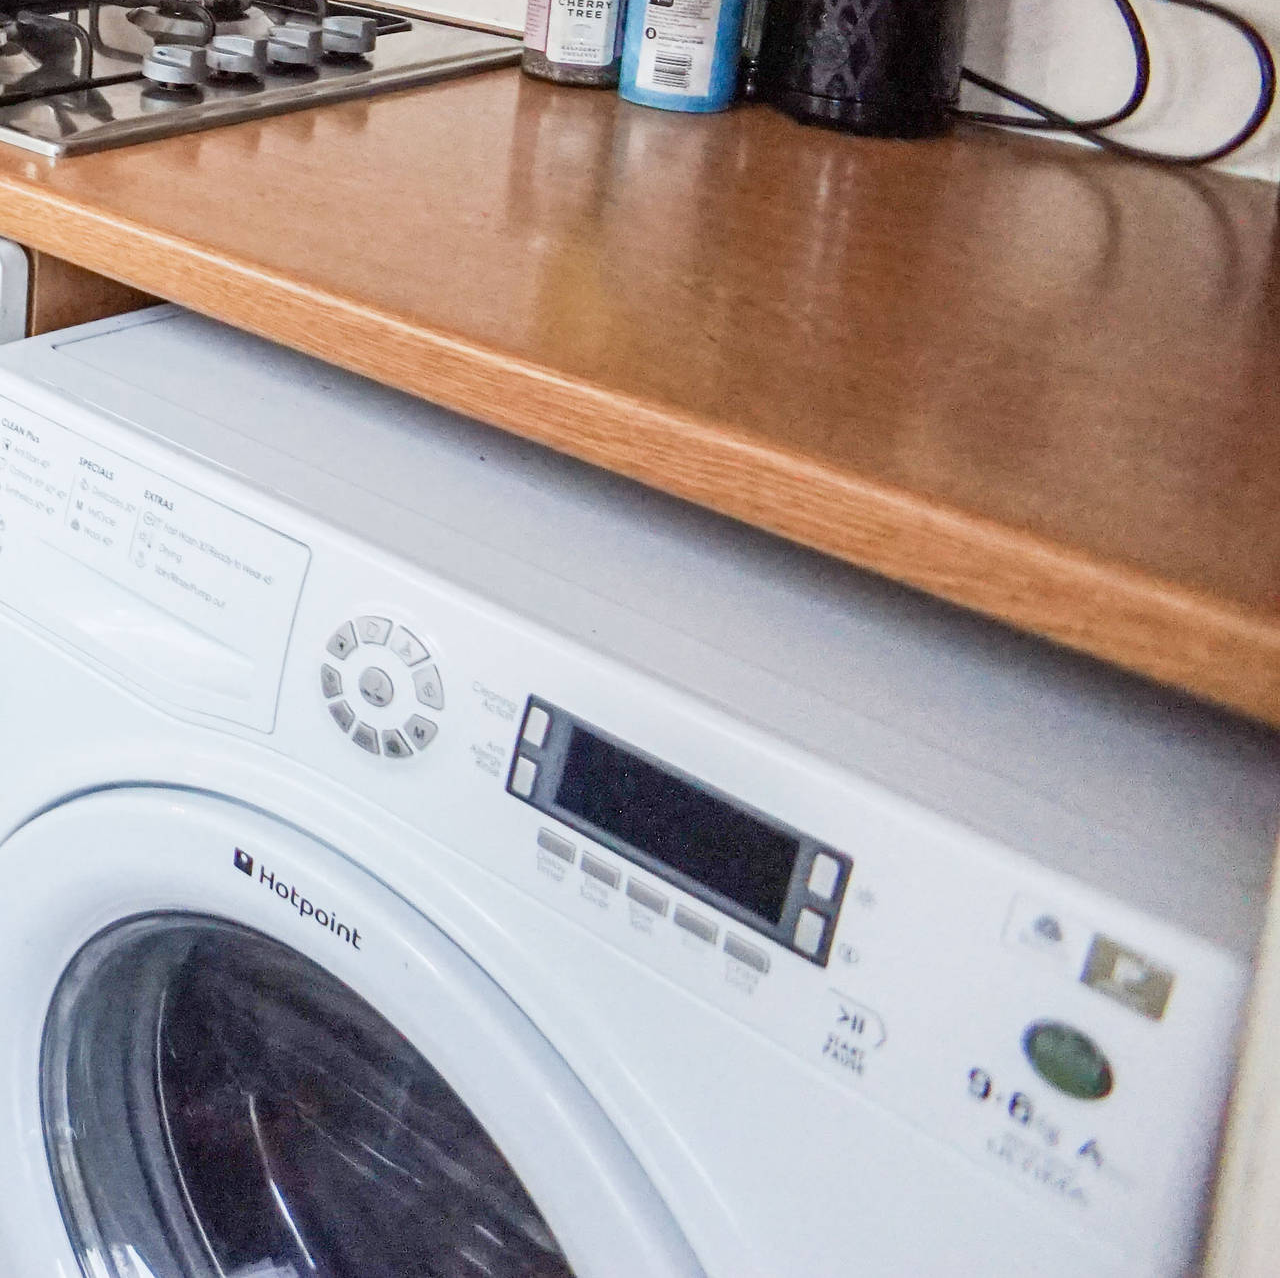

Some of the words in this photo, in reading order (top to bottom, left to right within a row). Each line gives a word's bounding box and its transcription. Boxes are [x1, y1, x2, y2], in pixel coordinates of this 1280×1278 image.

[567, 8, 603, 20] TREE
[79, 456, 114, 481] SPECIALS
[143, 489, 174, 511] EXTRAS
[259, 864, 362, 951] Hotpoint
